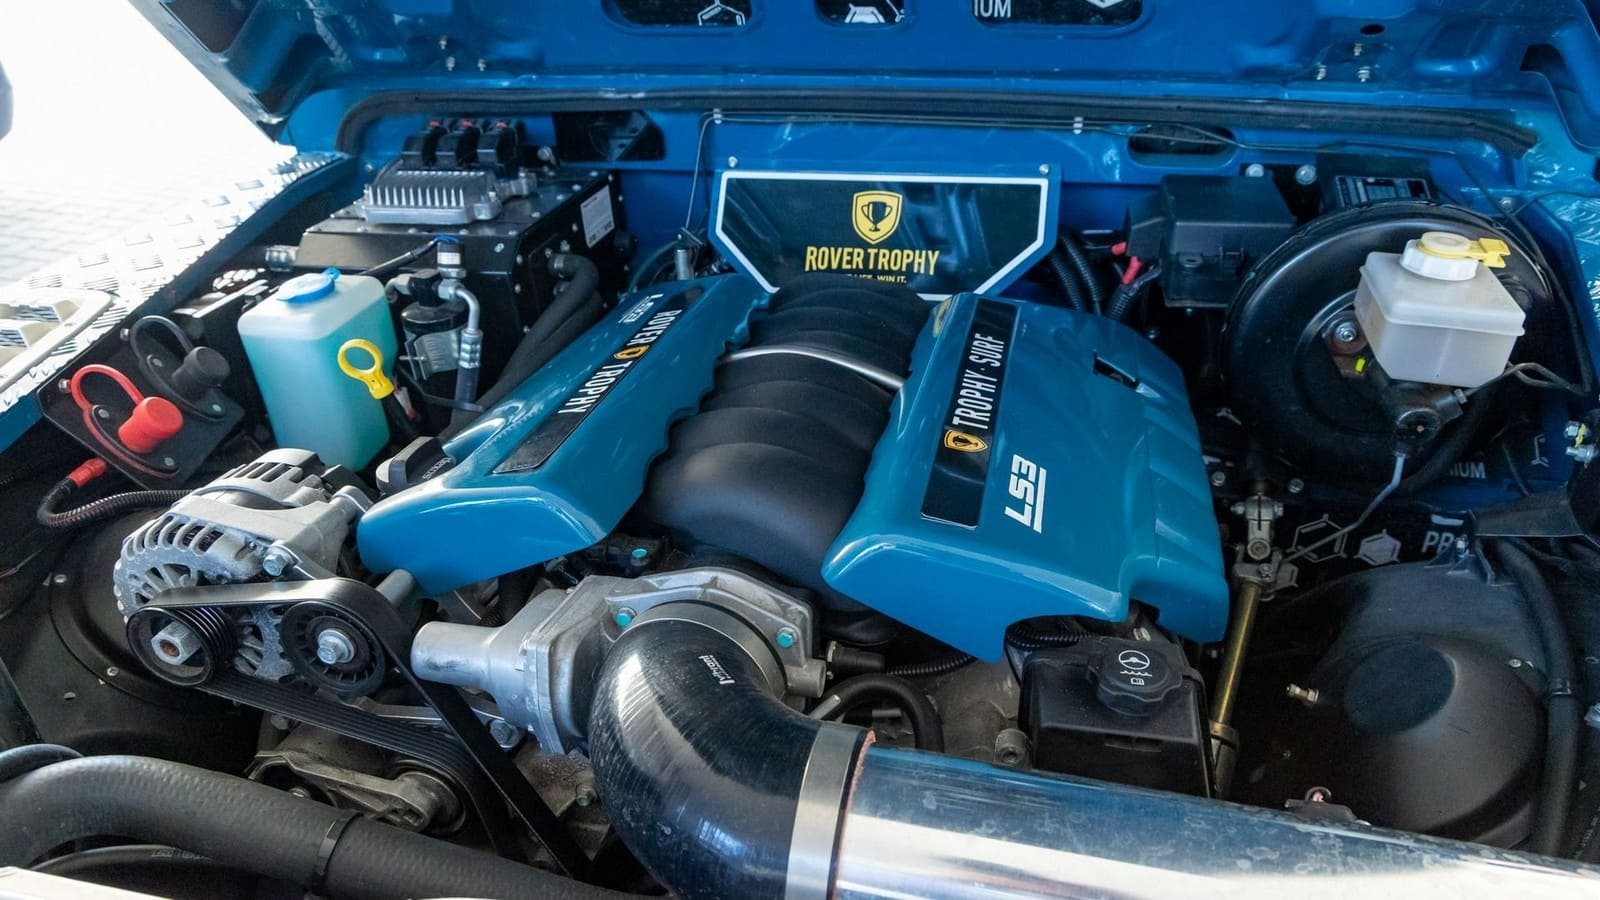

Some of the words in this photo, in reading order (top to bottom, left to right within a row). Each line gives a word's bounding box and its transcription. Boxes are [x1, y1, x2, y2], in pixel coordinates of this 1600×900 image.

[804, 246, 864, 272] ROVER
[867, 249, 940, 276] TROPHY
[627, 309, 682, 346] ROVER
[968, 333, 1005, 367] SURF
[558, 361, 632, 413] TROPHY
[952, 369, 998, 430] TROPHY
[1004, 453, 1038, 527] LS3
